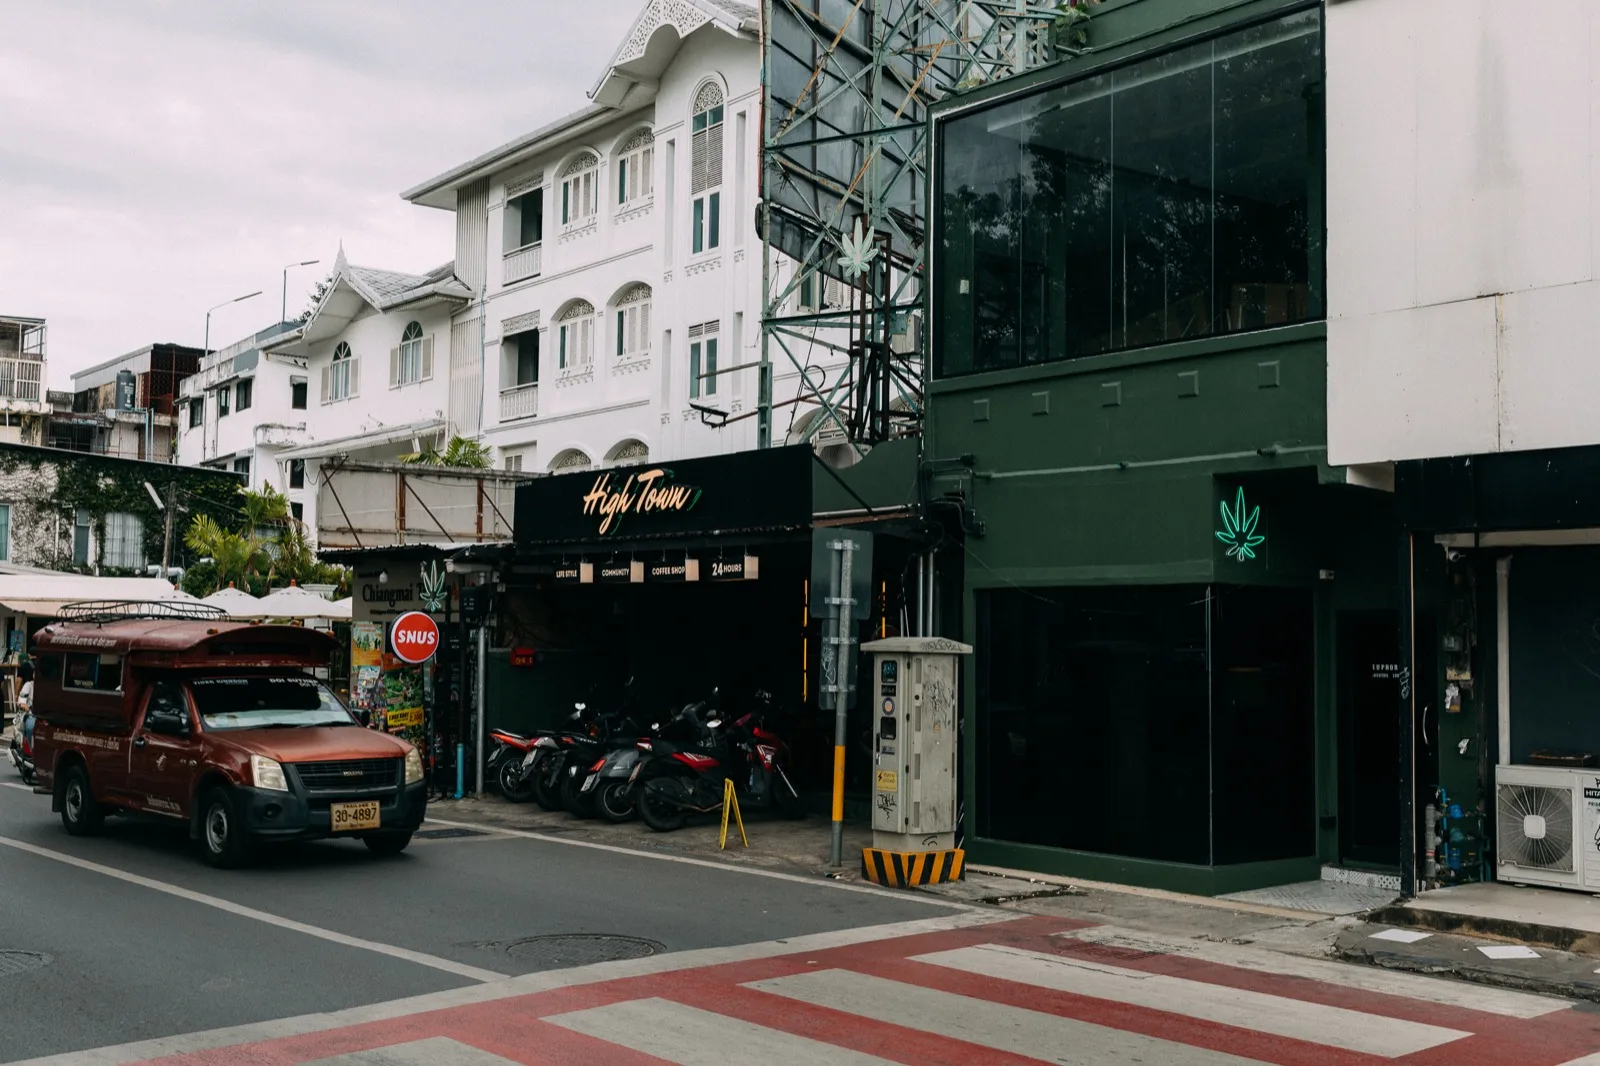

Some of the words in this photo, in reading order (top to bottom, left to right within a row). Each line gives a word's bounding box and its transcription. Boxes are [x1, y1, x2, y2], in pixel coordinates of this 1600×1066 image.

[583, 473, 635, 535] High
[637, 468, 692, 513] Town
[556, 570, 565, 578] LIFE
[565, 569, 578, 578] STYLE
[601, 568, 630, 577] COMMUNITY
[652, 567, 671, 576] COFFEE
[671, 566, 685, 575] SHOP
[712, 562, 723, 576] 24
[723, 563, 742, 573] HOURS
[362, 582, 413, 607] Chiangmai
[397, 629, 436, 645] SNUS
[335, 807, 377, 823] 30-4897
